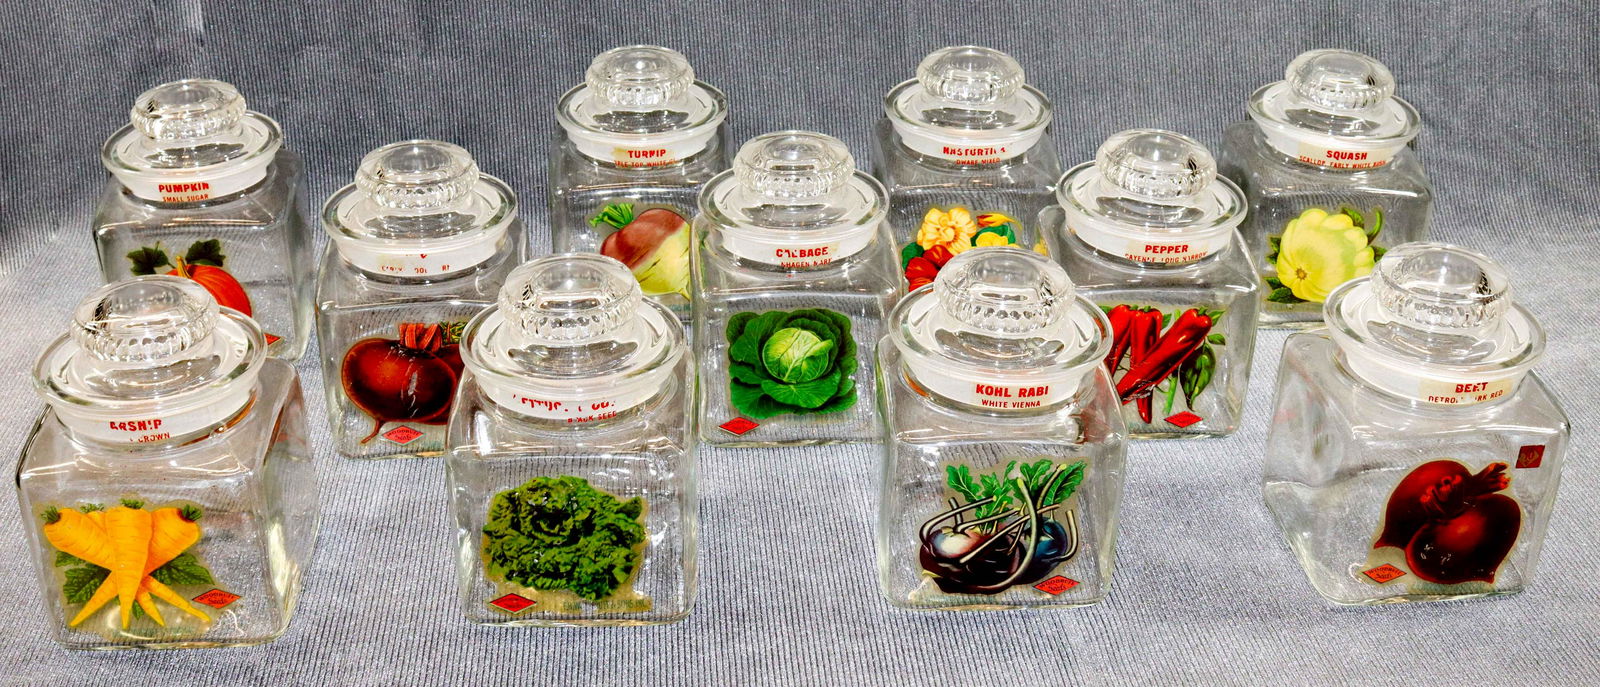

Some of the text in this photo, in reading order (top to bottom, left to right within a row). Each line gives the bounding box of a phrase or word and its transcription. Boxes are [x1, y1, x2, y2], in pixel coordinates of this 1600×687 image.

[627, 149, 667, 159] TURNIP
[1326, 150, 1368, 160] SQUASH
[158, 182, 210, 193] PUMPKIN
[187, 193, 209, 201] SUGAR
[1145, 244, 1189, 254] PEPPER
[976, 384, 1049, 398] KOHL RABI
[1455, 382, 1489, 393] BEET
[981, 399, 1041, 408] WHITE VIENNA
